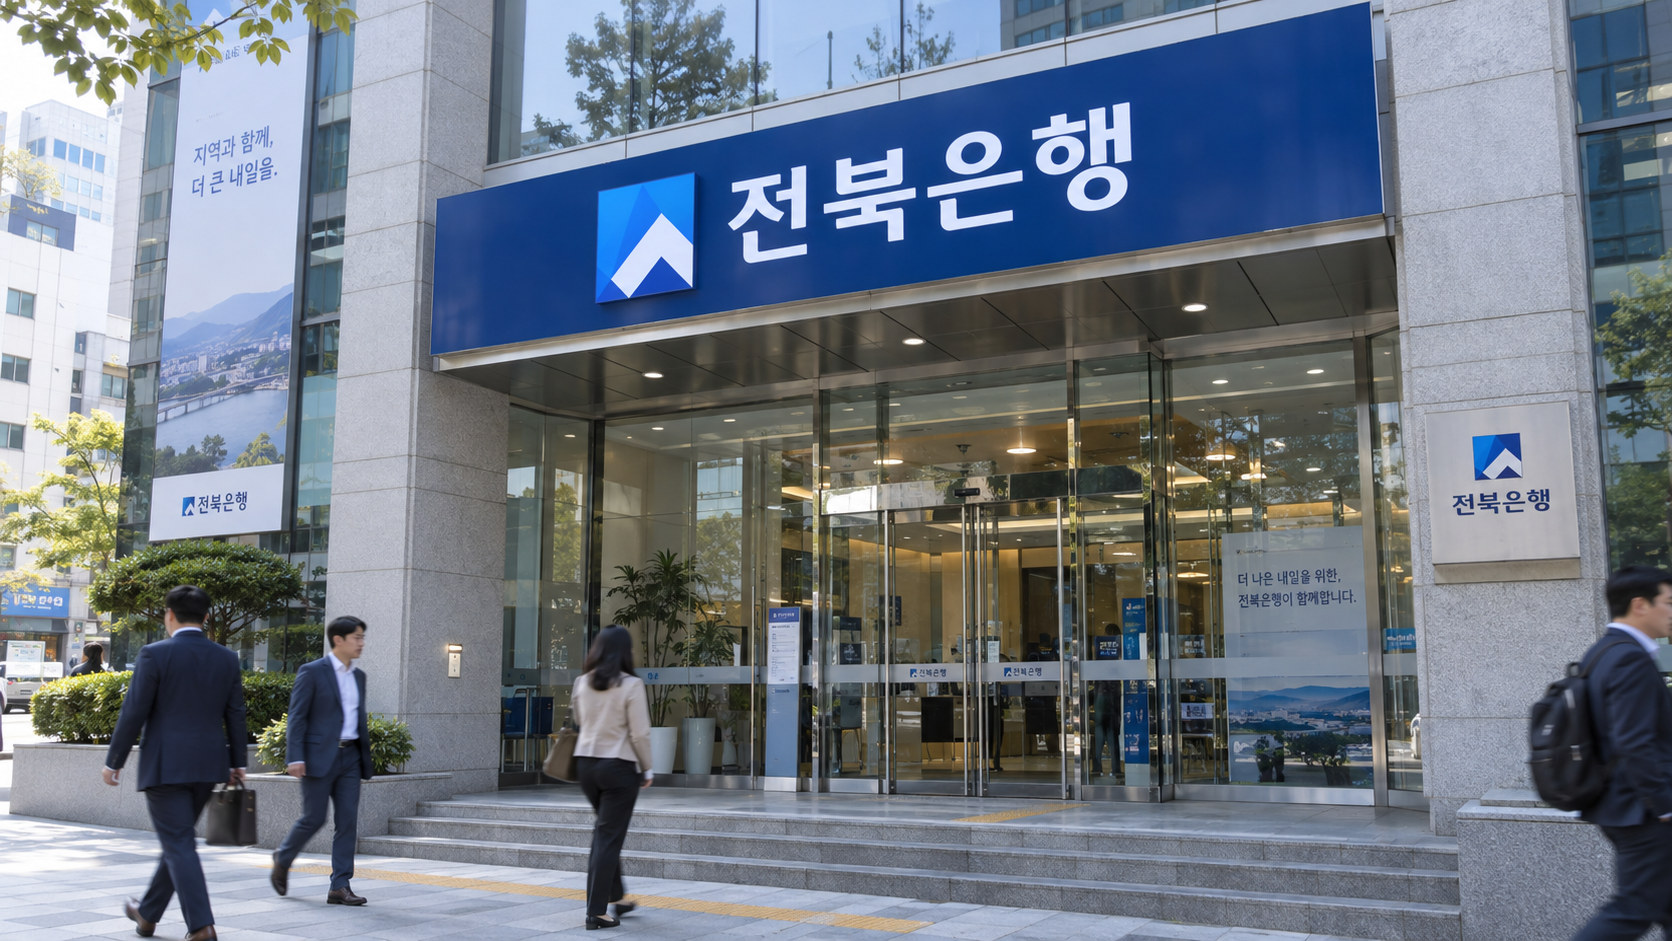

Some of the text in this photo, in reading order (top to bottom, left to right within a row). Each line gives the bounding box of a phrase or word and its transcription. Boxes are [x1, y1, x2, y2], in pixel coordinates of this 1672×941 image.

[193, 125, 274, 167] 지역과 함께,
[191, 156, 278, 198] 더 큰 내일을.
[728, 101, 1133, 264] 전북은행
[198, 491, 248, 515] 전북은행
[1452, 488, 1551, 516] 전북은행
[1237, 567, 1341, 587] 더 나은 내일을 위한,
[1238, 588, 1357, 608] 전북은행이 함께합니다.
